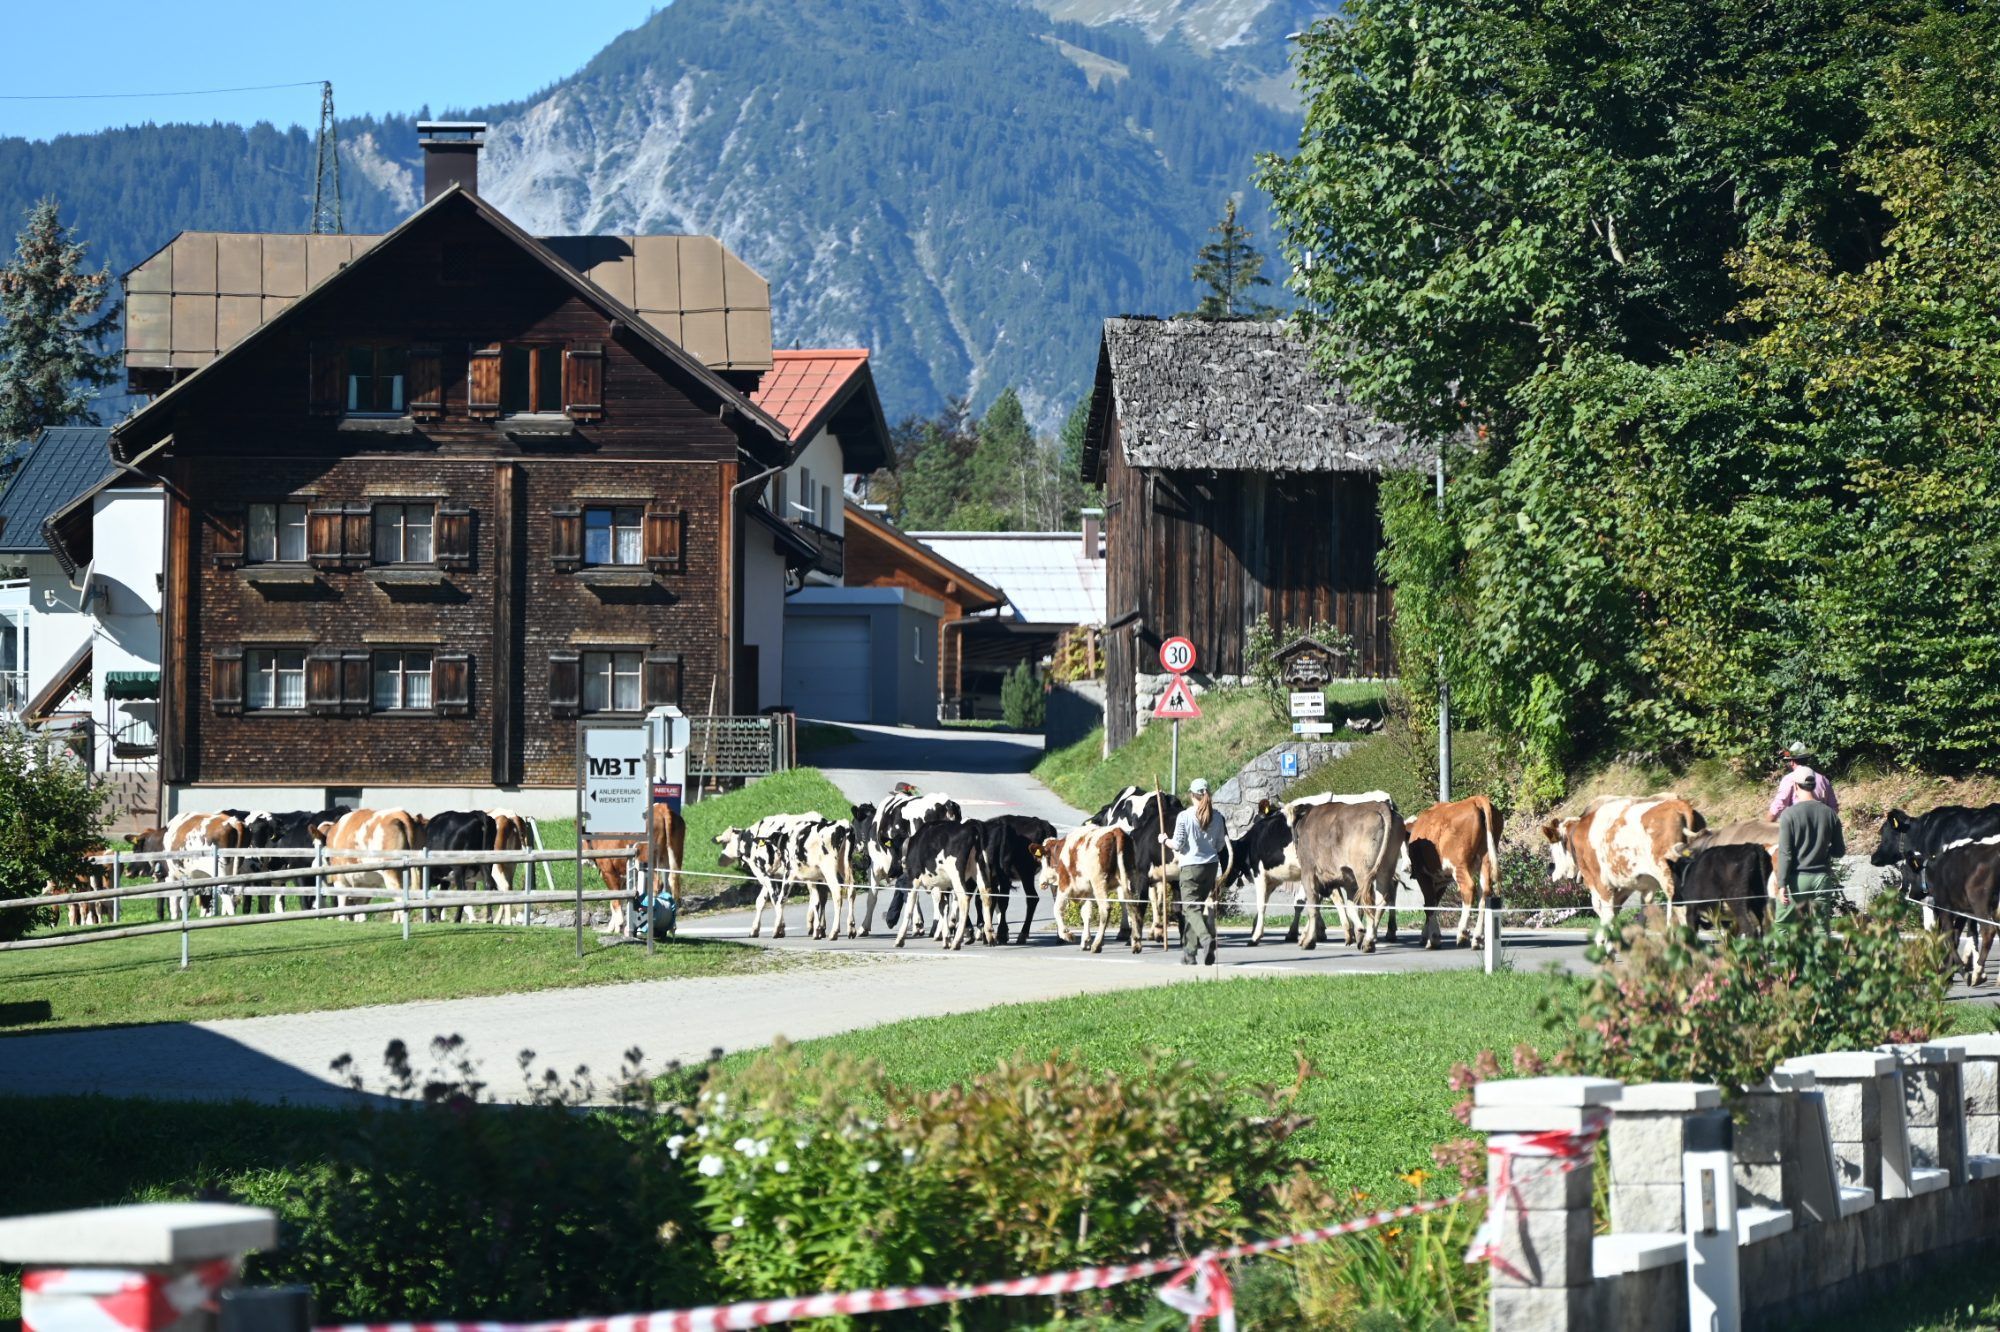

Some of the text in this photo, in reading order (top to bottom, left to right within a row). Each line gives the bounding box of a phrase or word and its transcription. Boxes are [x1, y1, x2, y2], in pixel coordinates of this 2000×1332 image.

[1169, 646, 1188, 664] 30
[590, 758, 640, 776] MBT
[1284, 754, 1294, 769] P
